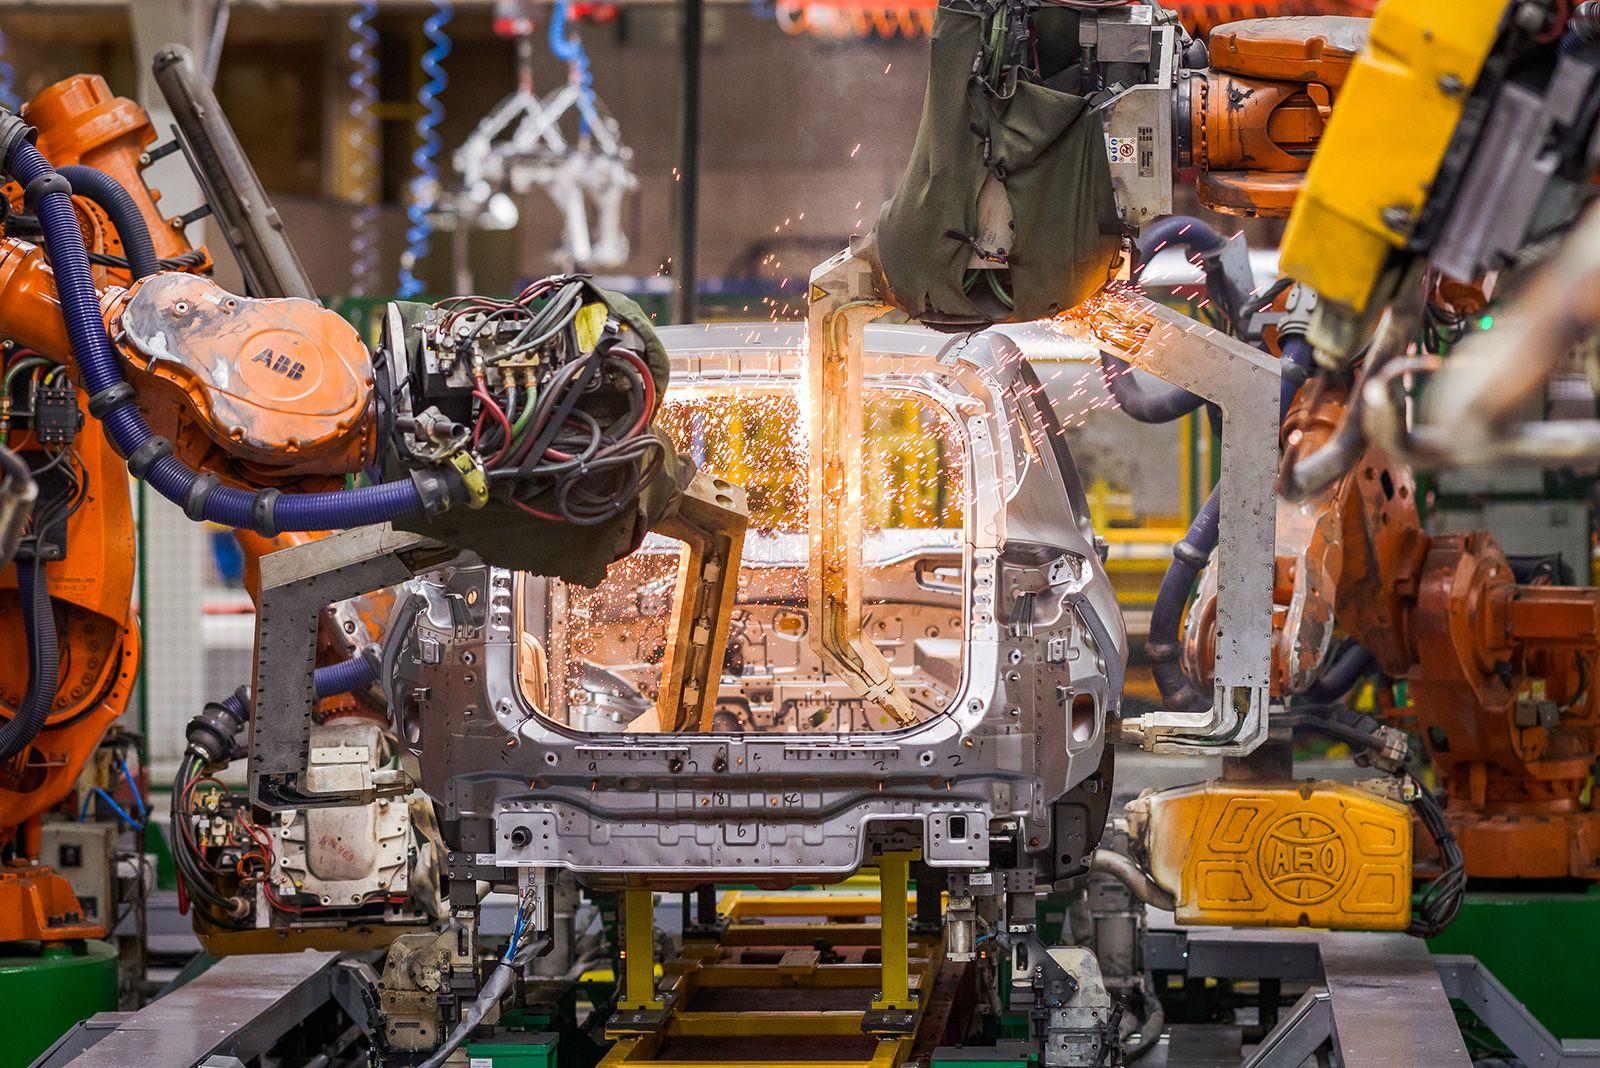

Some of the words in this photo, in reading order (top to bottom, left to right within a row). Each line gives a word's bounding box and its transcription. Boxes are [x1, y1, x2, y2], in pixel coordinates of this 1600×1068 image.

[251, 347, 306, 381] ABB
[737, 822, 746, 838] 6
[1271, 840, 1338, 876] ARO
